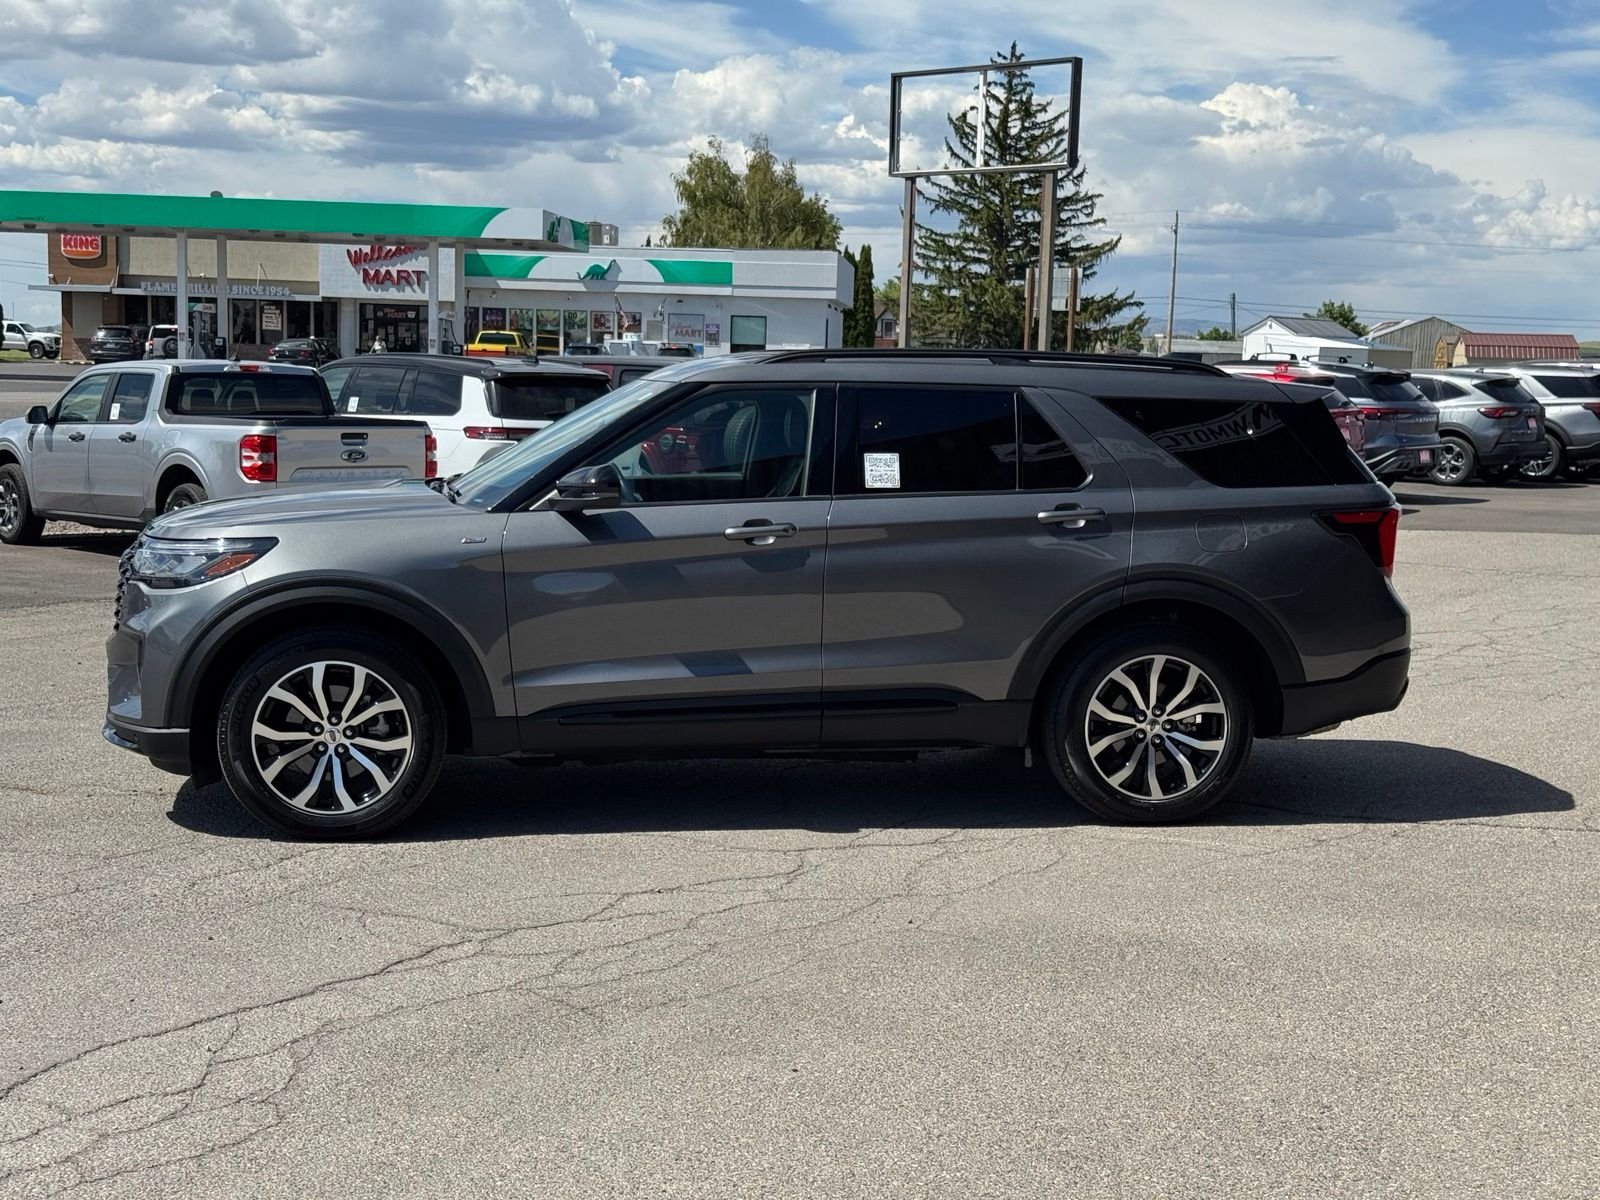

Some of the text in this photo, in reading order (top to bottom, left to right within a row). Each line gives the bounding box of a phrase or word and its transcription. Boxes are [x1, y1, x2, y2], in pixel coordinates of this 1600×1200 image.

[62, 236, 100, 250] KING
[362, 267, 427, 287] MART
[140, 281, 177, 293] FLAME
[230, 284, 264, 295] SINCE
[264, 286, 290, 297] 1954
[674, 329, 703, 338] MART
